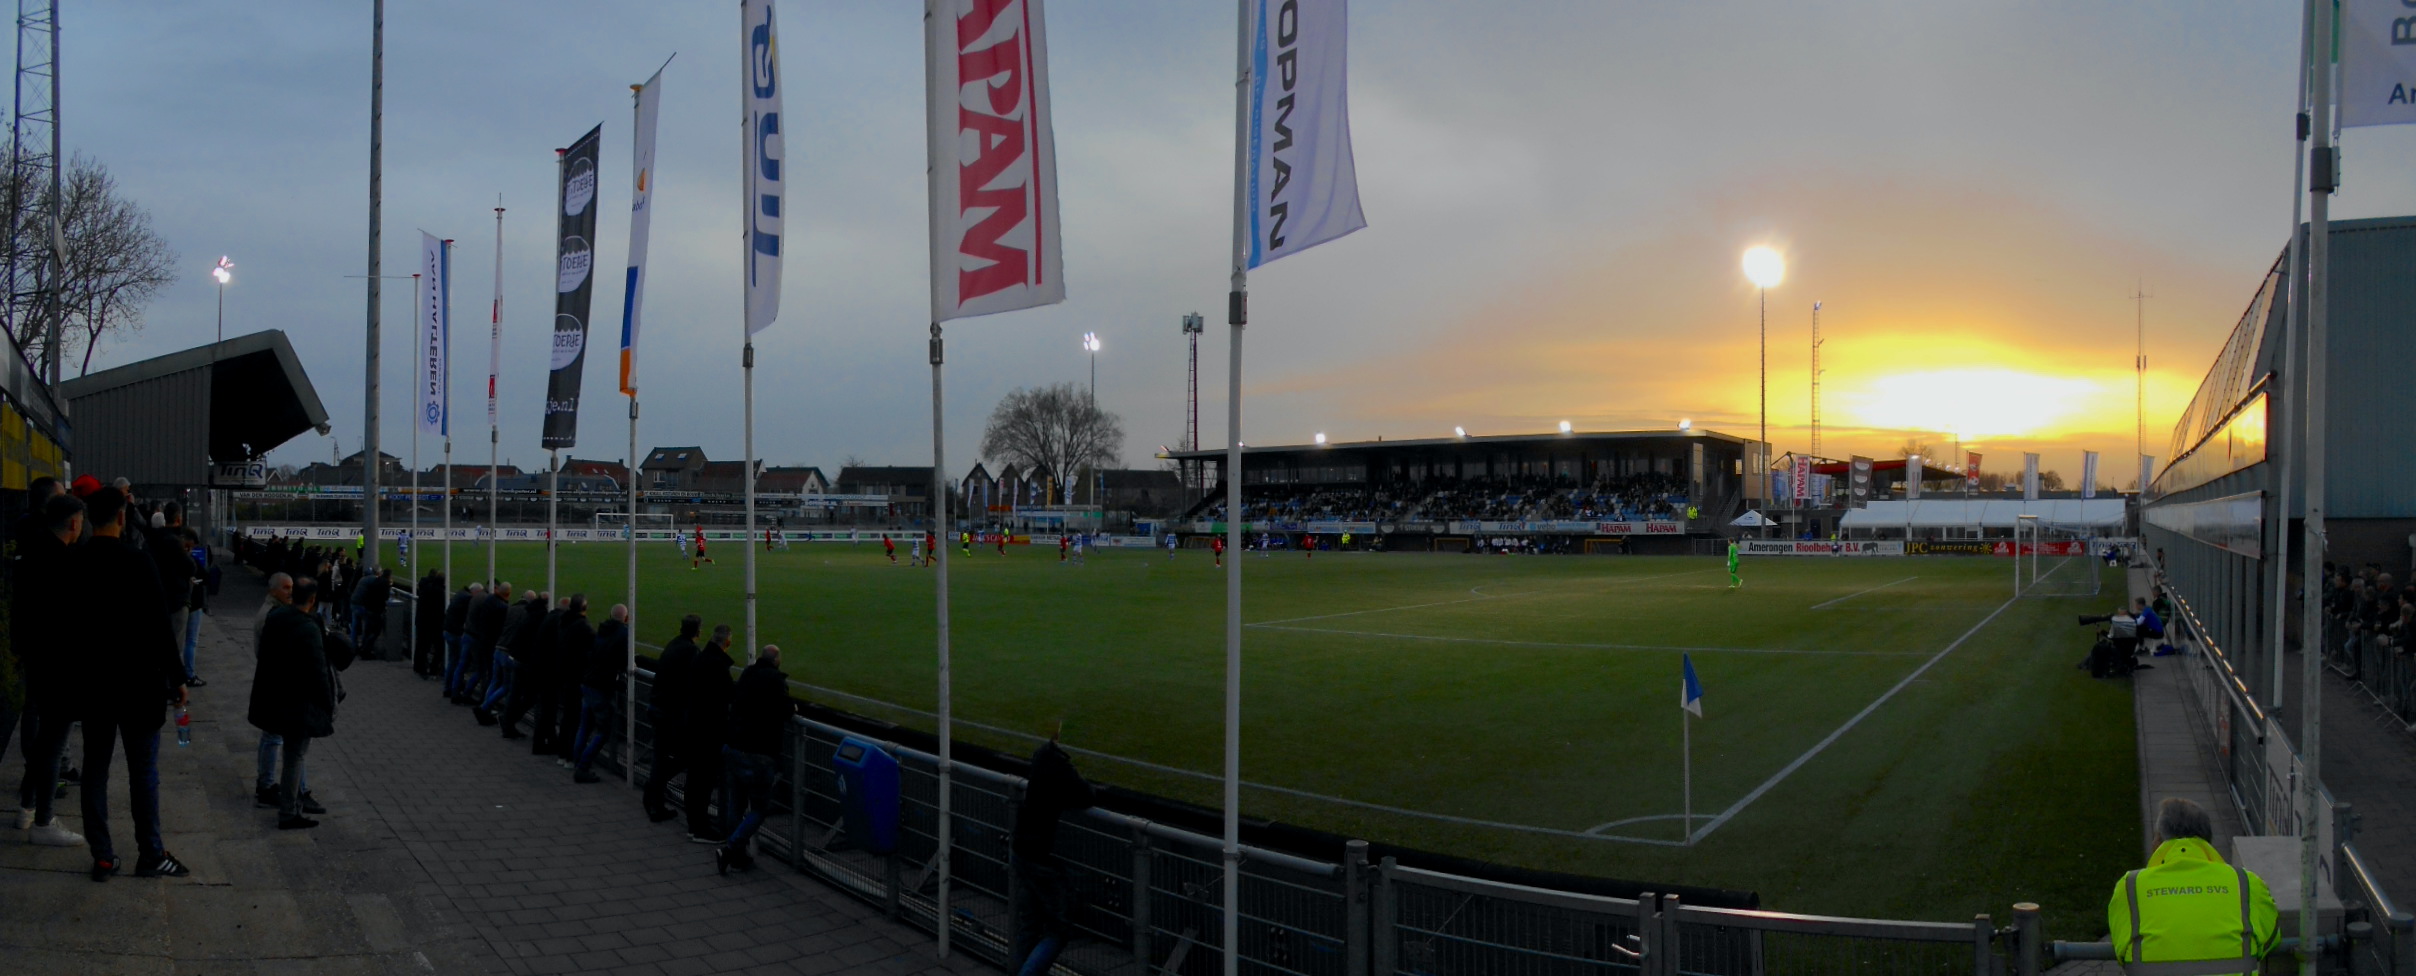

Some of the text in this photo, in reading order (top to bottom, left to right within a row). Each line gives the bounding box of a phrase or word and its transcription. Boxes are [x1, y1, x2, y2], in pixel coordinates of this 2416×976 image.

[219, 462, 263, 478] TinQ
[1797, 457, 1808, 497] HAPAM
[253, 528, 275, 536] TinQ
[285, 528, 308, 536] TinQ
[317, 528, 340, 536] TinQ
[506, 529, 528, 537] TinQ
[1601, 523, 1631, 533] HAPAM
[1646, 523, 1677, 533] HAPAM
[566, 530, 588, 538] TinQ
[1748, 542, 1860, 554] Amerongen Rioolbehr B.V.
[1905, 542, 1928, 554] JPC
[2146, 885, 2229, 898] STEWARD SVS
